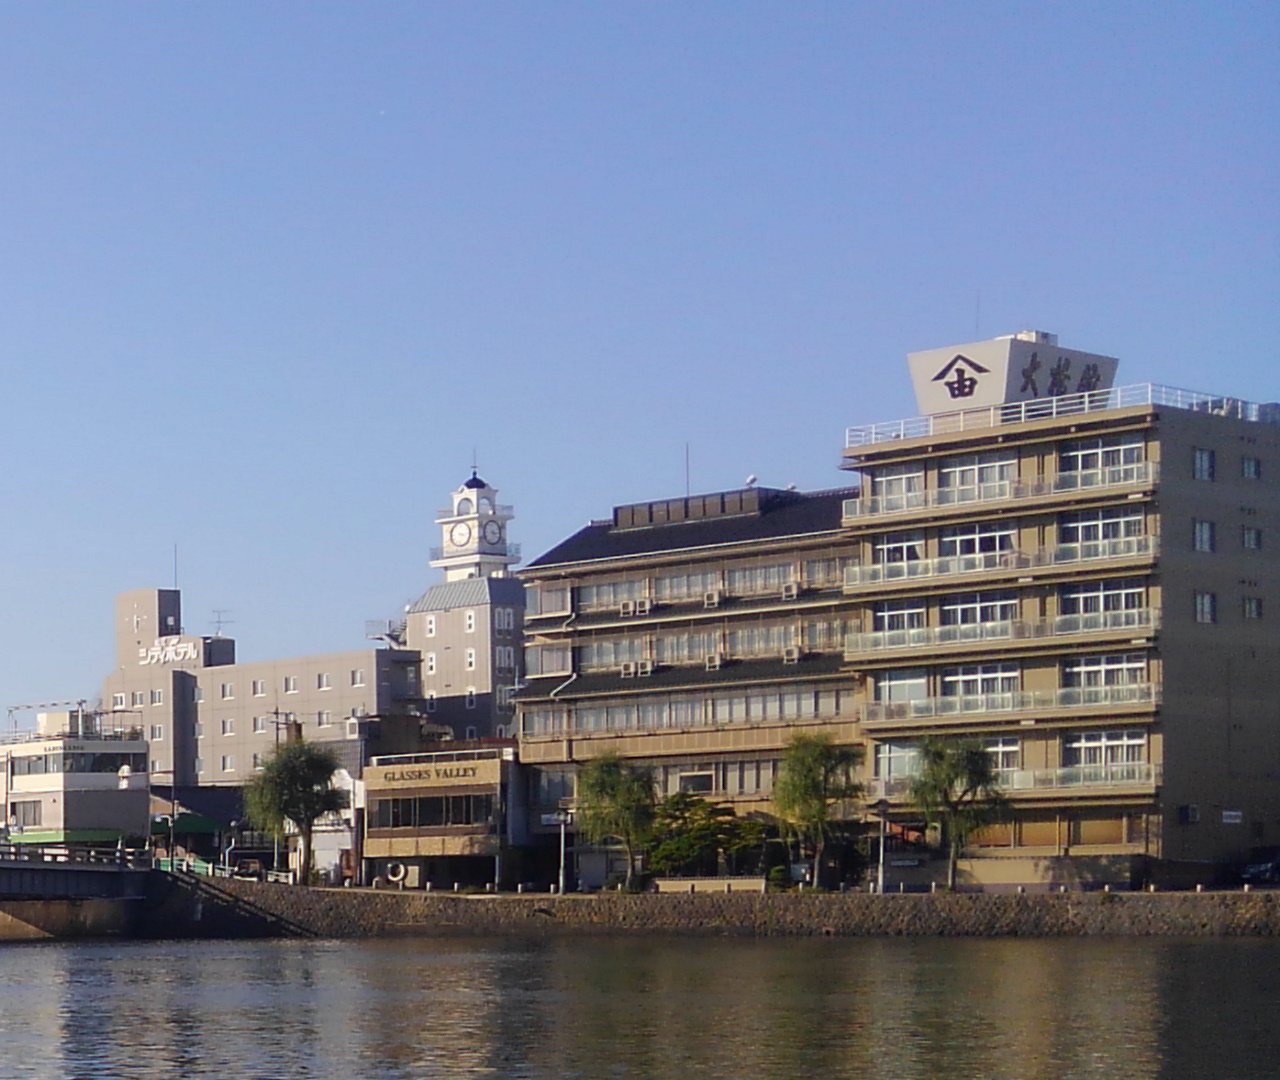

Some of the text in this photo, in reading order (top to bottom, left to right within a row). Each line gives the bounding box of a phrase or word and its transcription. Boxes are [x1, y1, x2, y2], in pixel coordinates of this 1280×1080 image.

[139, 642, 198, 665] シティホテル
[384, 767, 478, 781] GLASSES VALLEY
